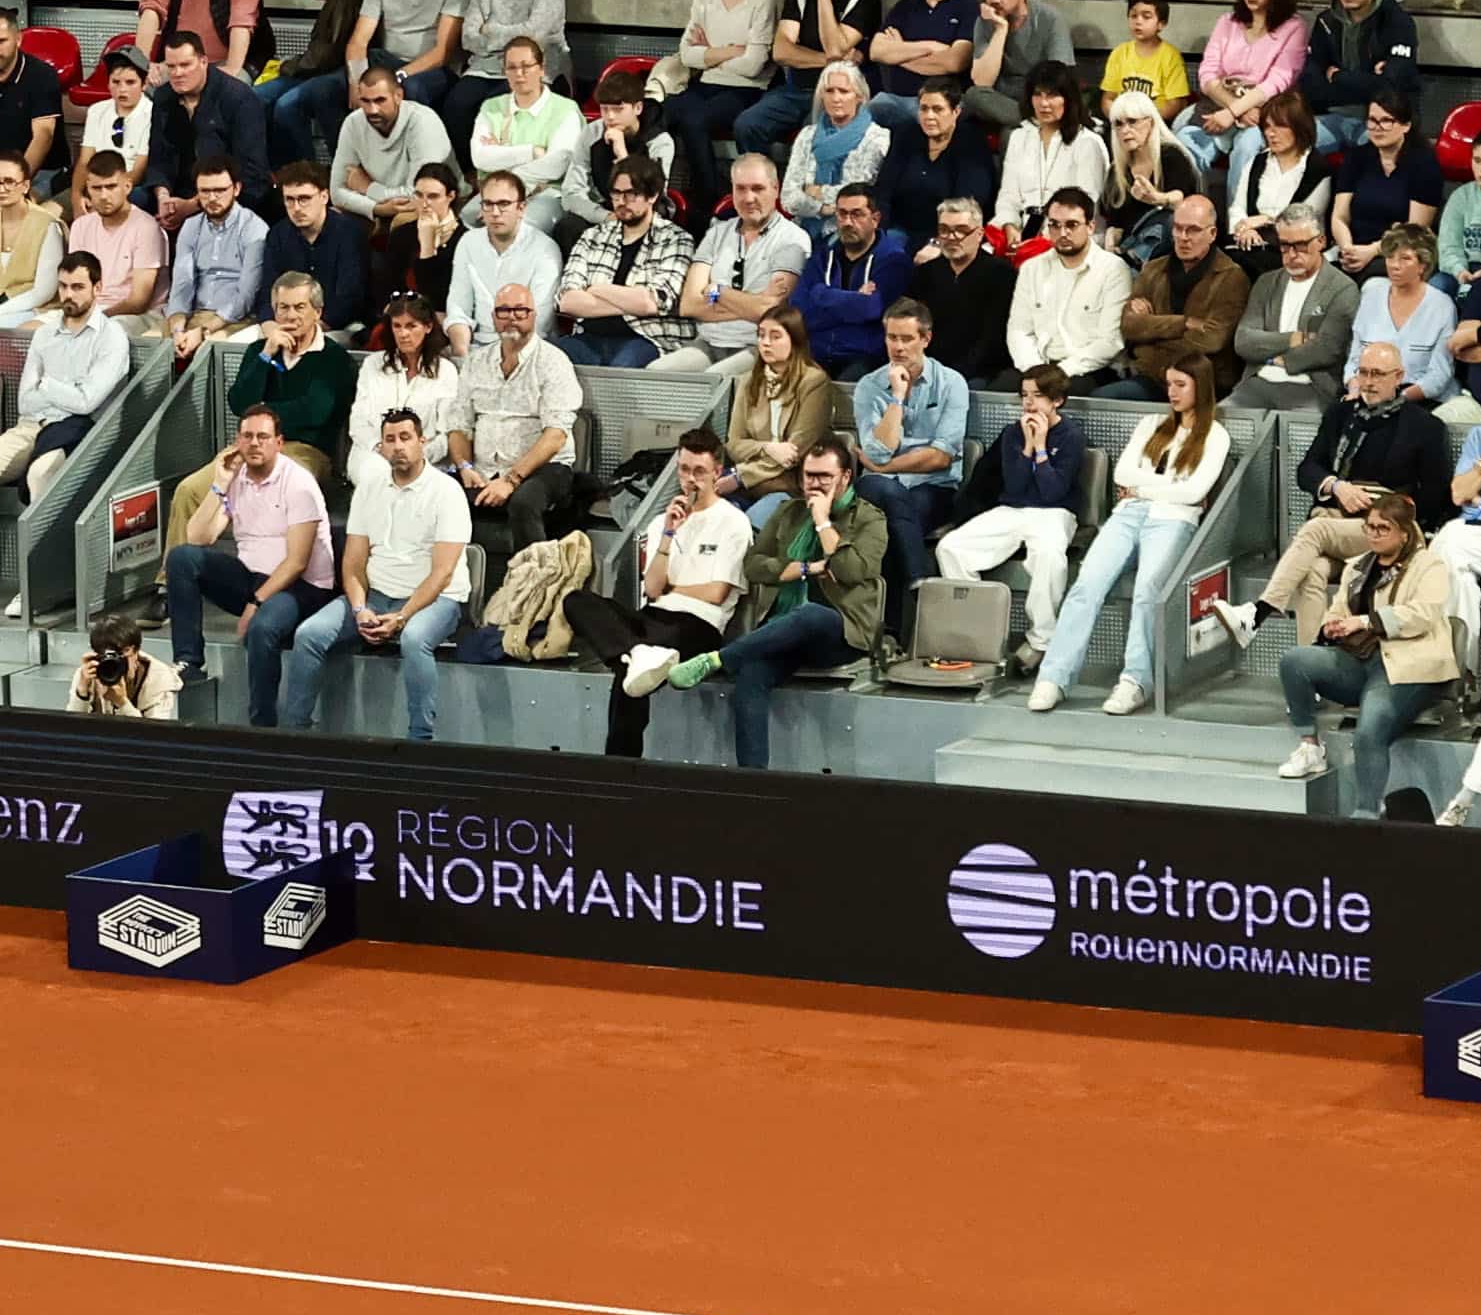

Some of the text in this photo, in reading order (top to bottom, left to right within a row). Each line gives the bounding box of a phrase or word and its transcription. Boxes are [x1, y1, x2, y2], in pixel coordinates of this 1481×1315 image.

[396, 805, 574, 859] RÉGION
[398, 853, 765, 931] NORMANDIE
[1069, 859, 1372, 937] métropole
